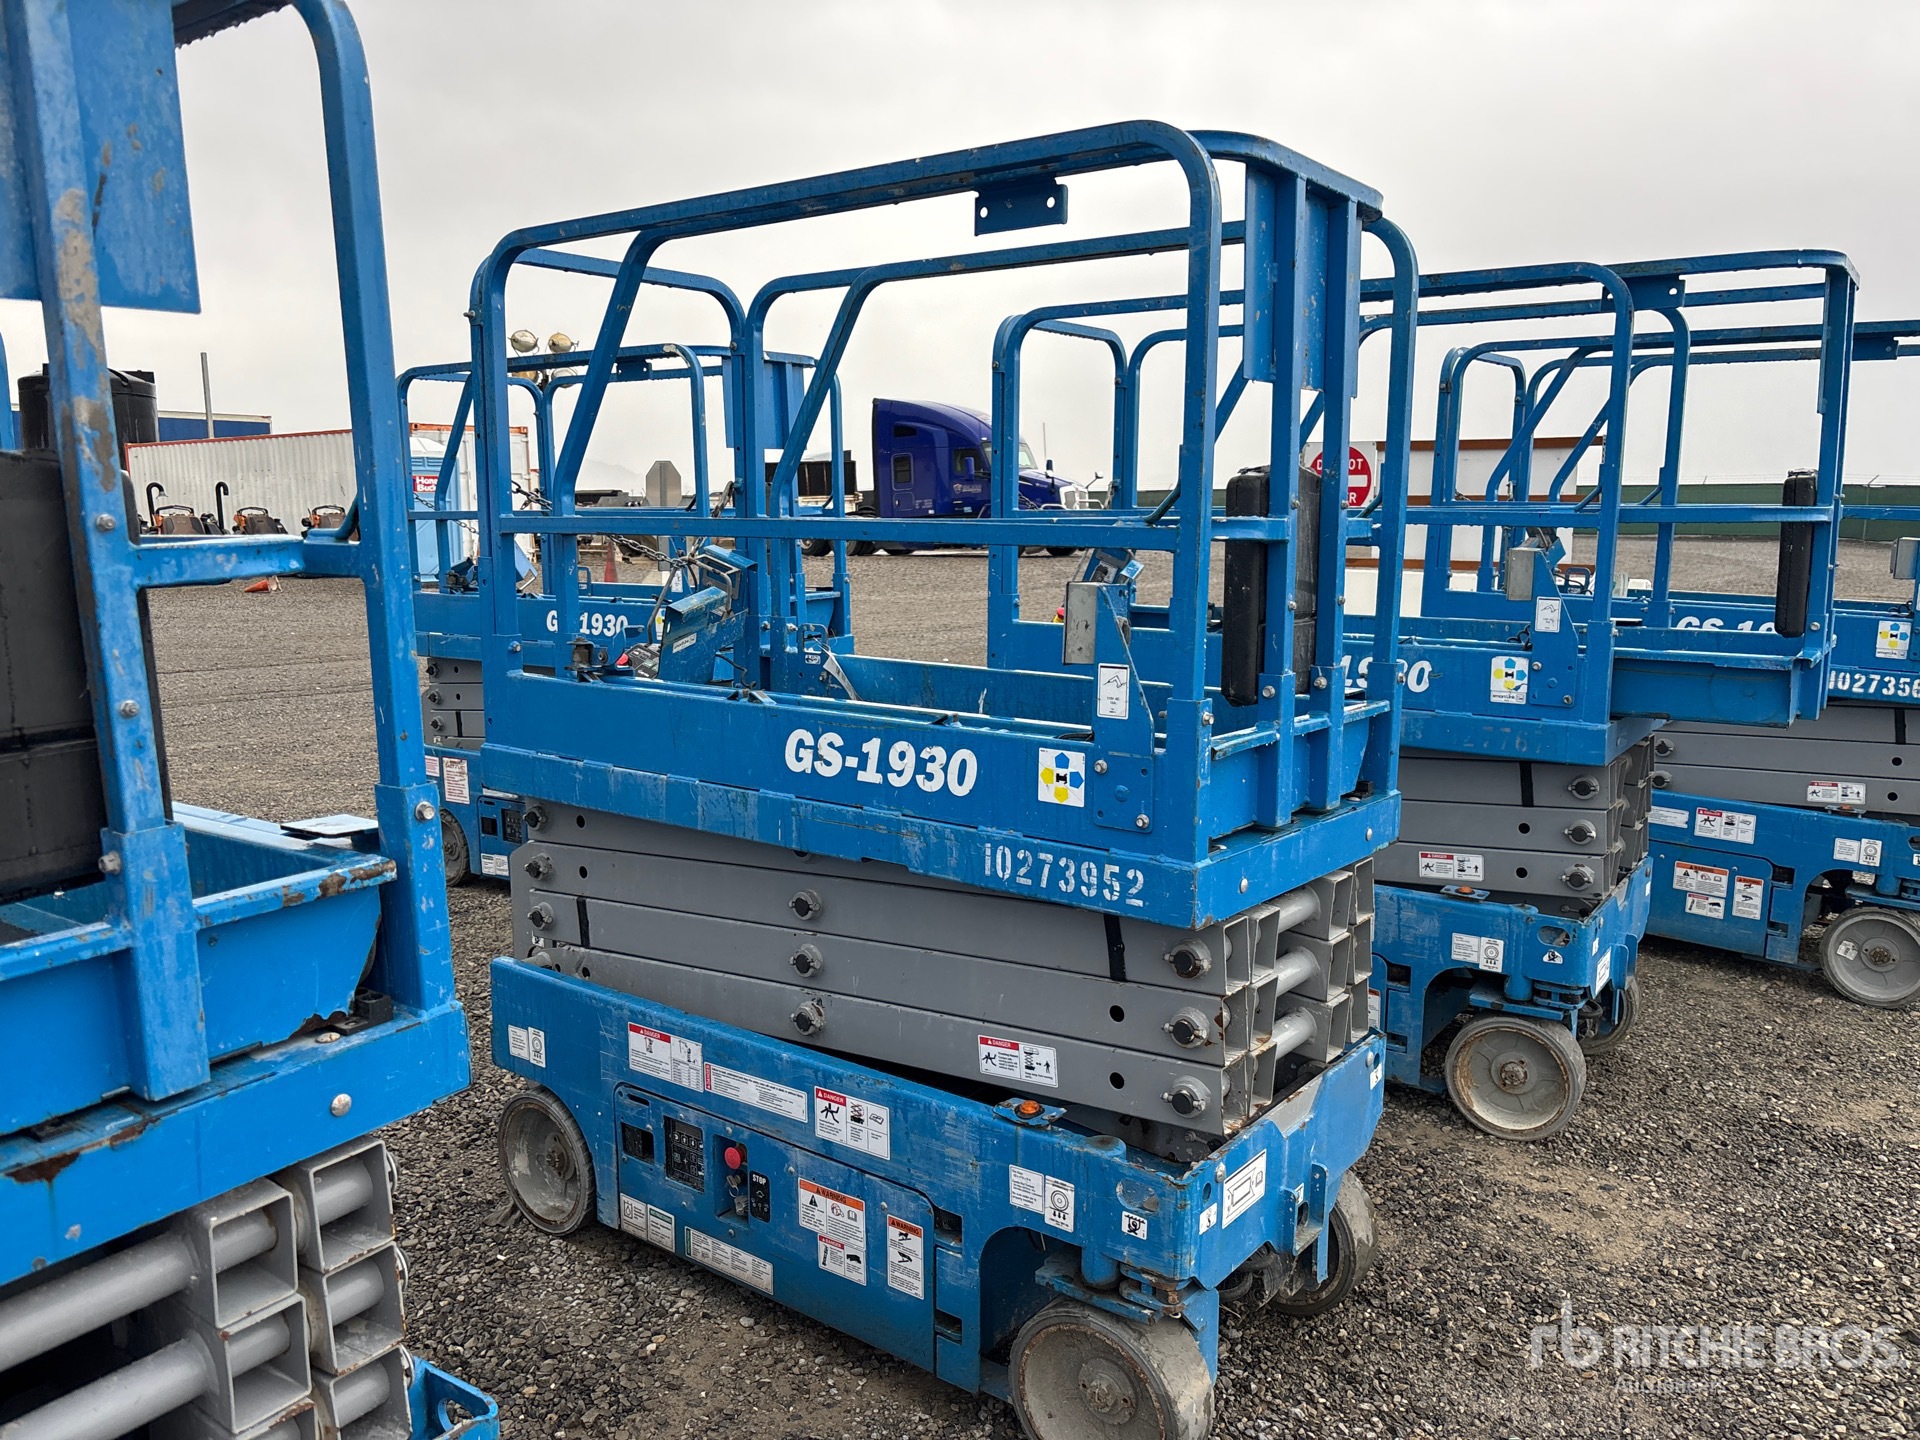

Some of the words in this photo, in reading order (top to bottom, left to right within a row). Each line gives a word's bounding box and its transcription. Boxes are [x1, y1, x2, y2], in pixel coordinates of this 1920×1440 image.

[546, 609, 628, 637] G1930
[784, 728, 978, 797] GS-1930
[984, 842, 1145, 908] 10273952
[643, 1028, 661, 1040] DANGER
[992, 1039, 1011, 1048] DANGER
[823, 1092, 844, 1104] DANGER
[752, 1174, 767, 1185] STOP
[821, 1189, 847, 1205] WARNING
[896, 1221, 920, 1236] WARNING
